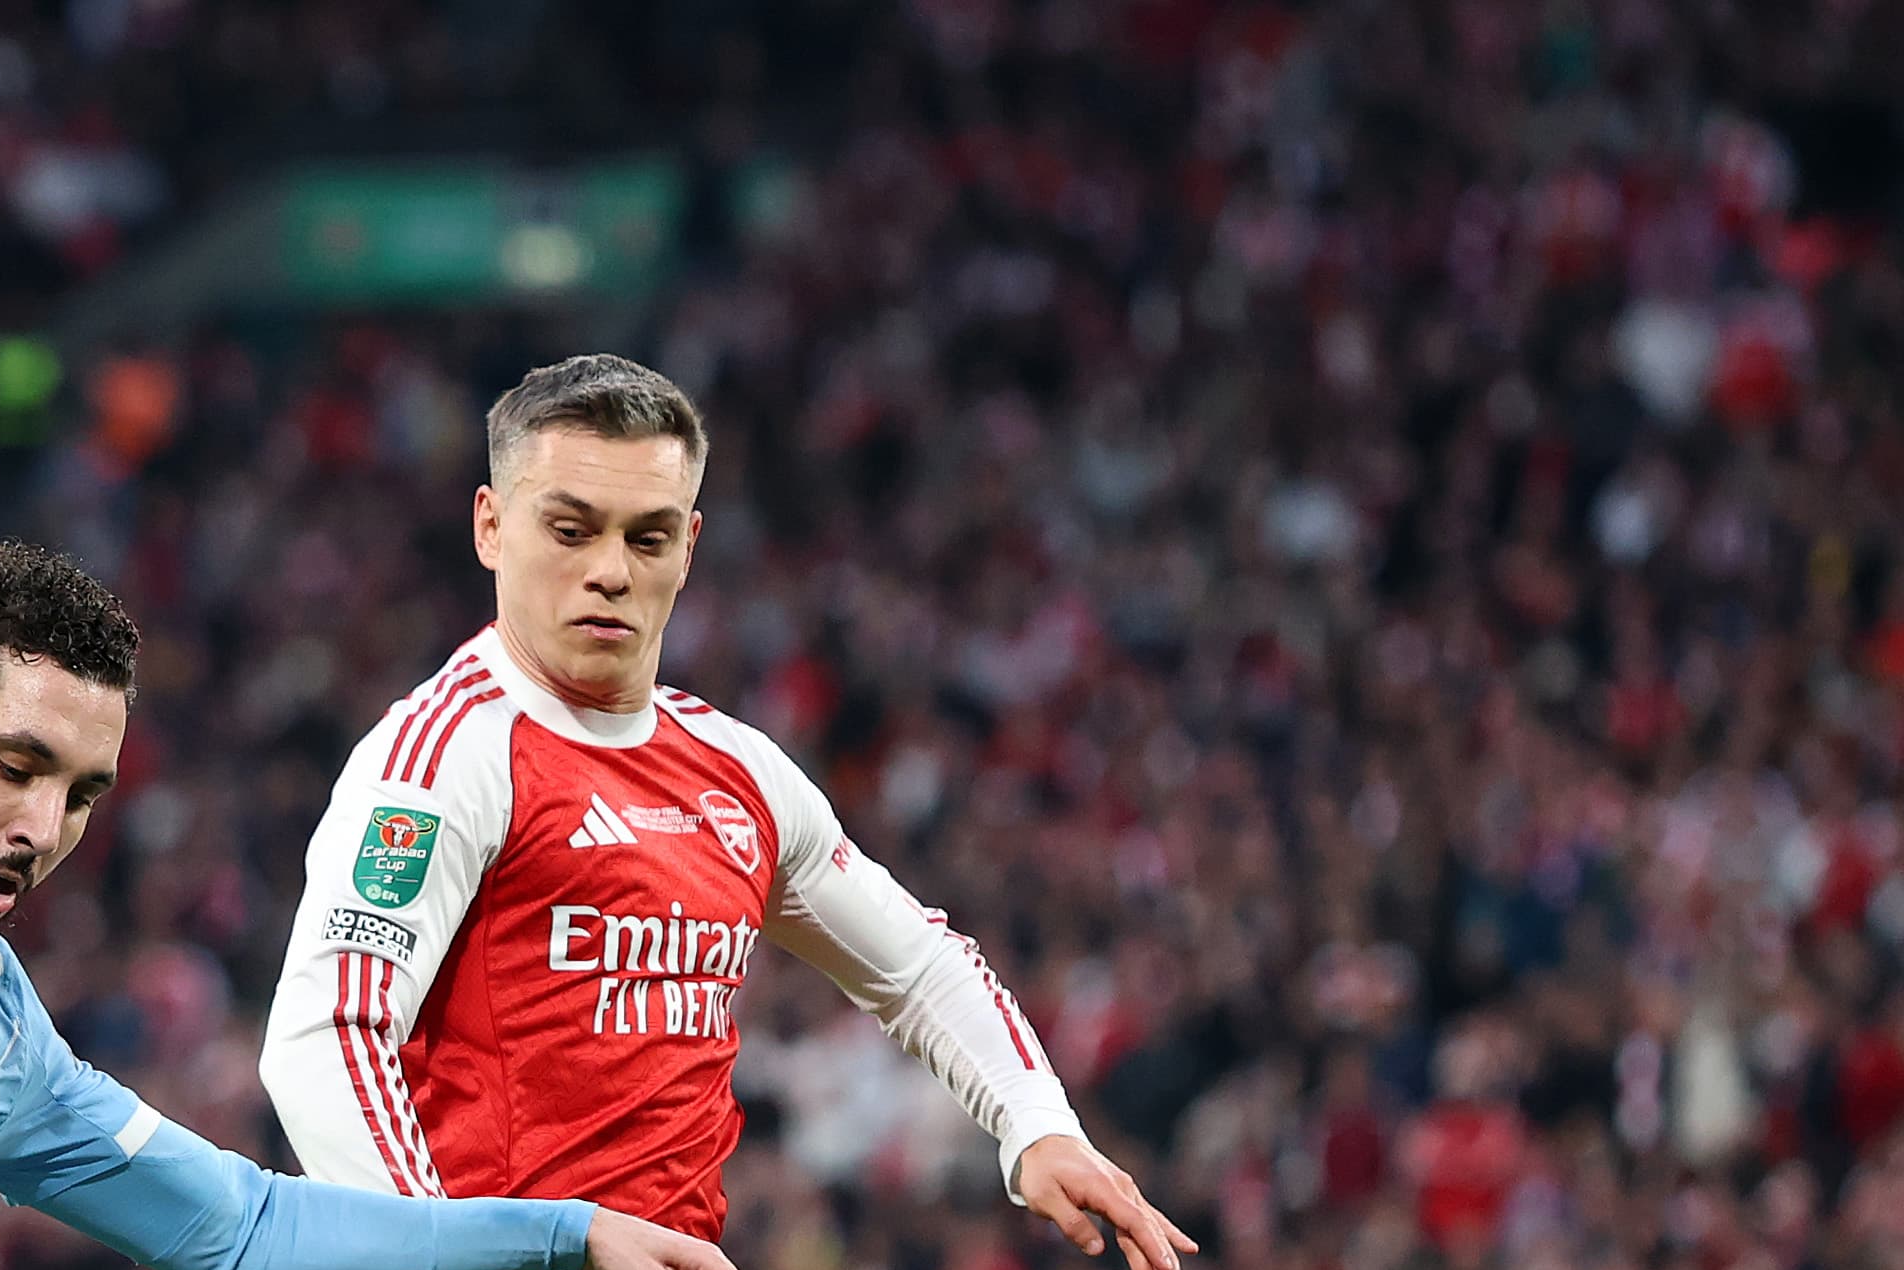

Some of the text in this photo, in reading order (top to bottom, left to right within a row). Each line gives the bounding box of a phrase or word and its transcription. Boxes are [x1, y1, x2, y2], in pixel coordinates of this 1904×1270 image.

[361, 844, 427, 860] Carabao
[375, 857, 407, 872] Cup
[382, 875, 394, 884] 2
[381, 890, 401, 904] EFL
[327, 908, 409, 946] No room
[351, 928, 413, 965] racism
[593, 976, 651, 1035] FLY
